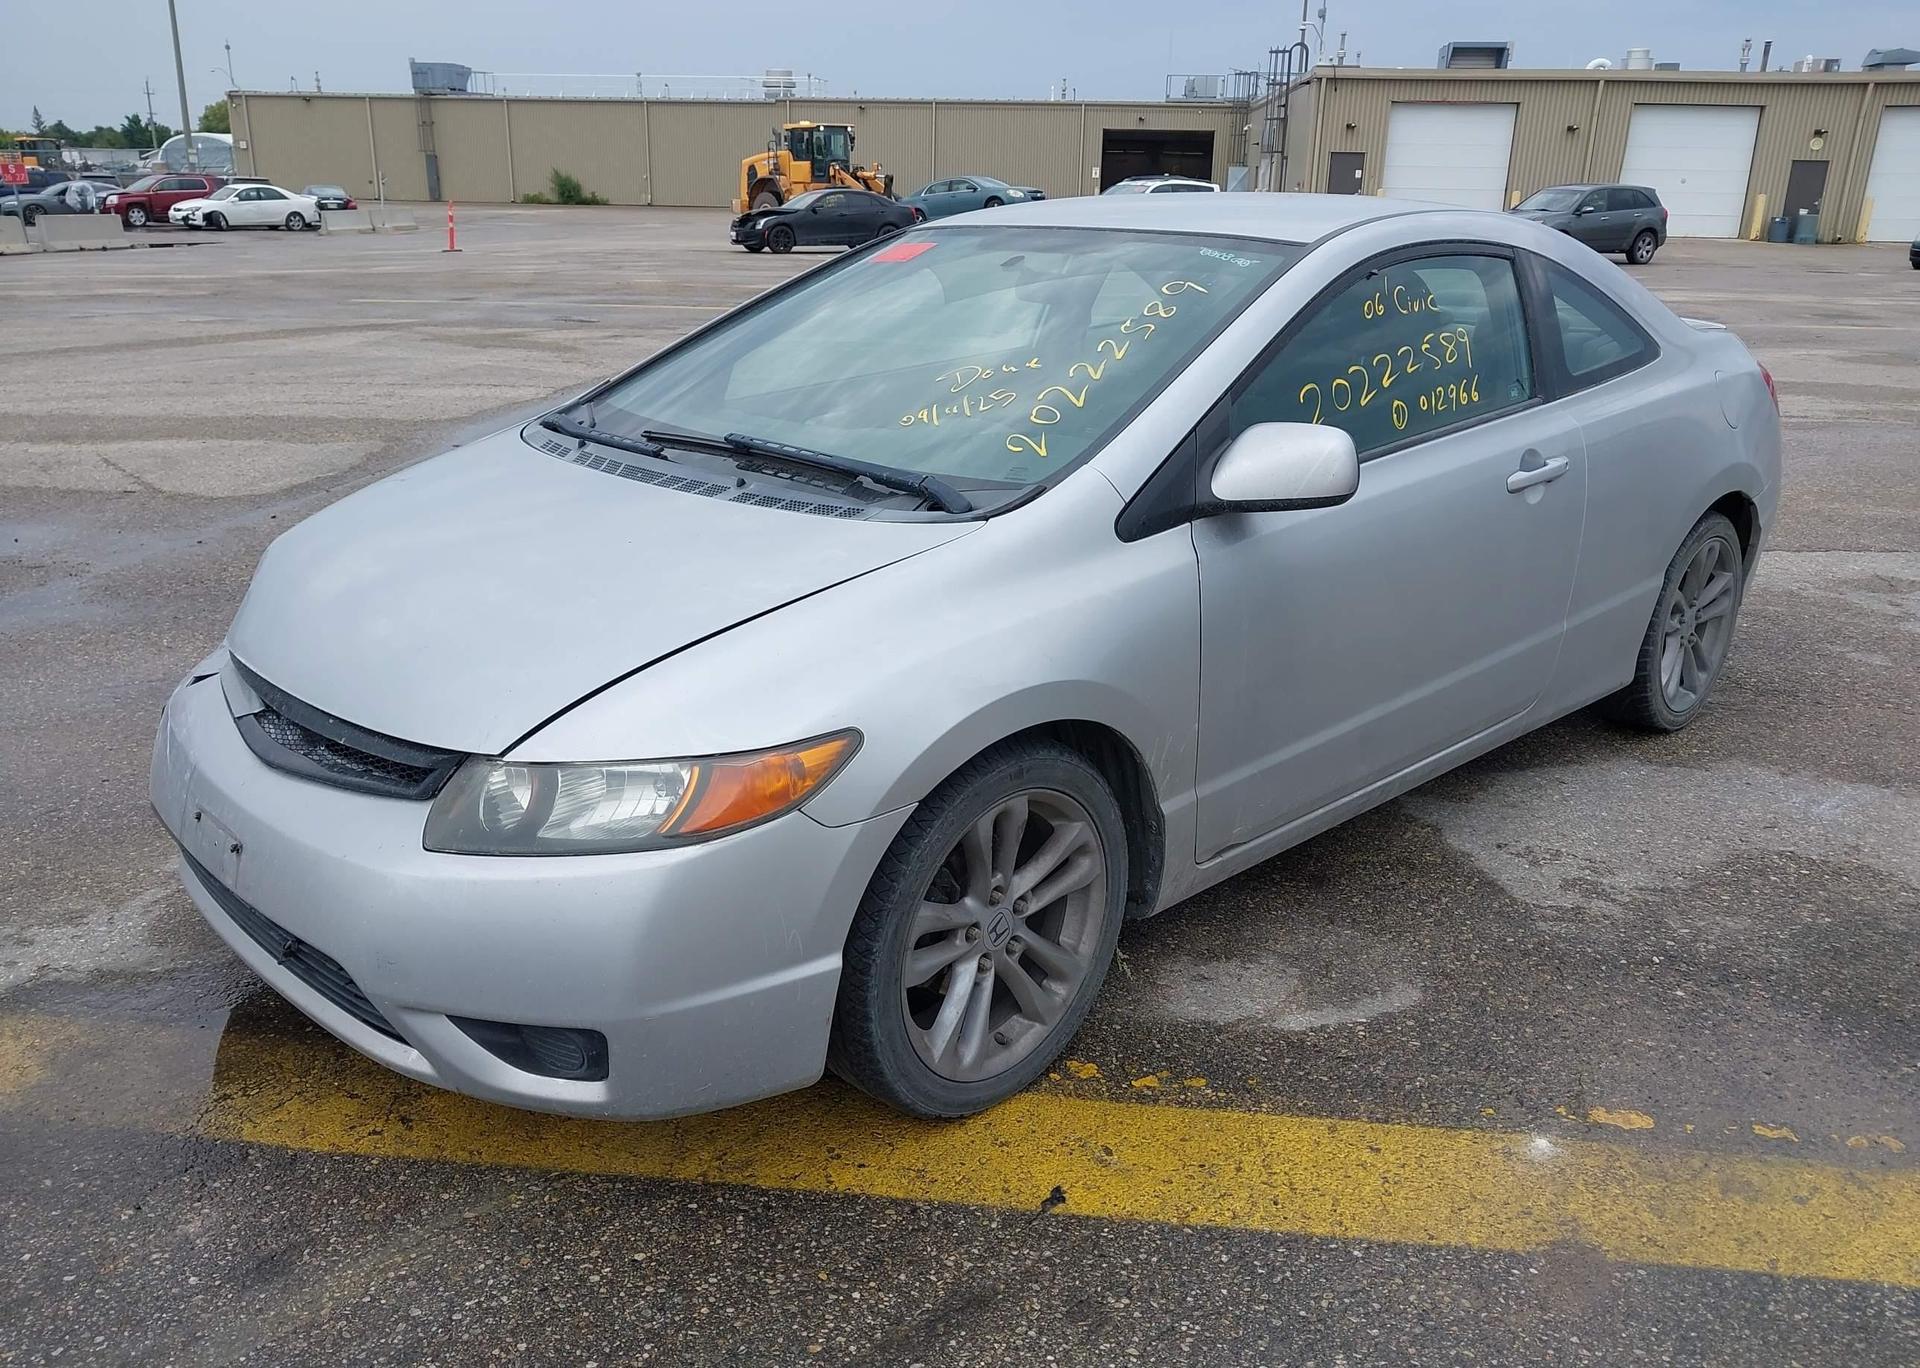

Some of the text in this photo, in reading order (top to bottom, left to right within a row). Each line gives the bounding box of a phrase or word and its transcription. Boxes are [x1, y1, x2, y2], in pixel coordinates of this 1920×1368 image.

[1394, 286, 1443, 315] Civic
[1007, 281, 1208, 457] 20222589
[1301, 328, 1472, 424] 20222589
[1420, 375, 1480, 415] 012966
